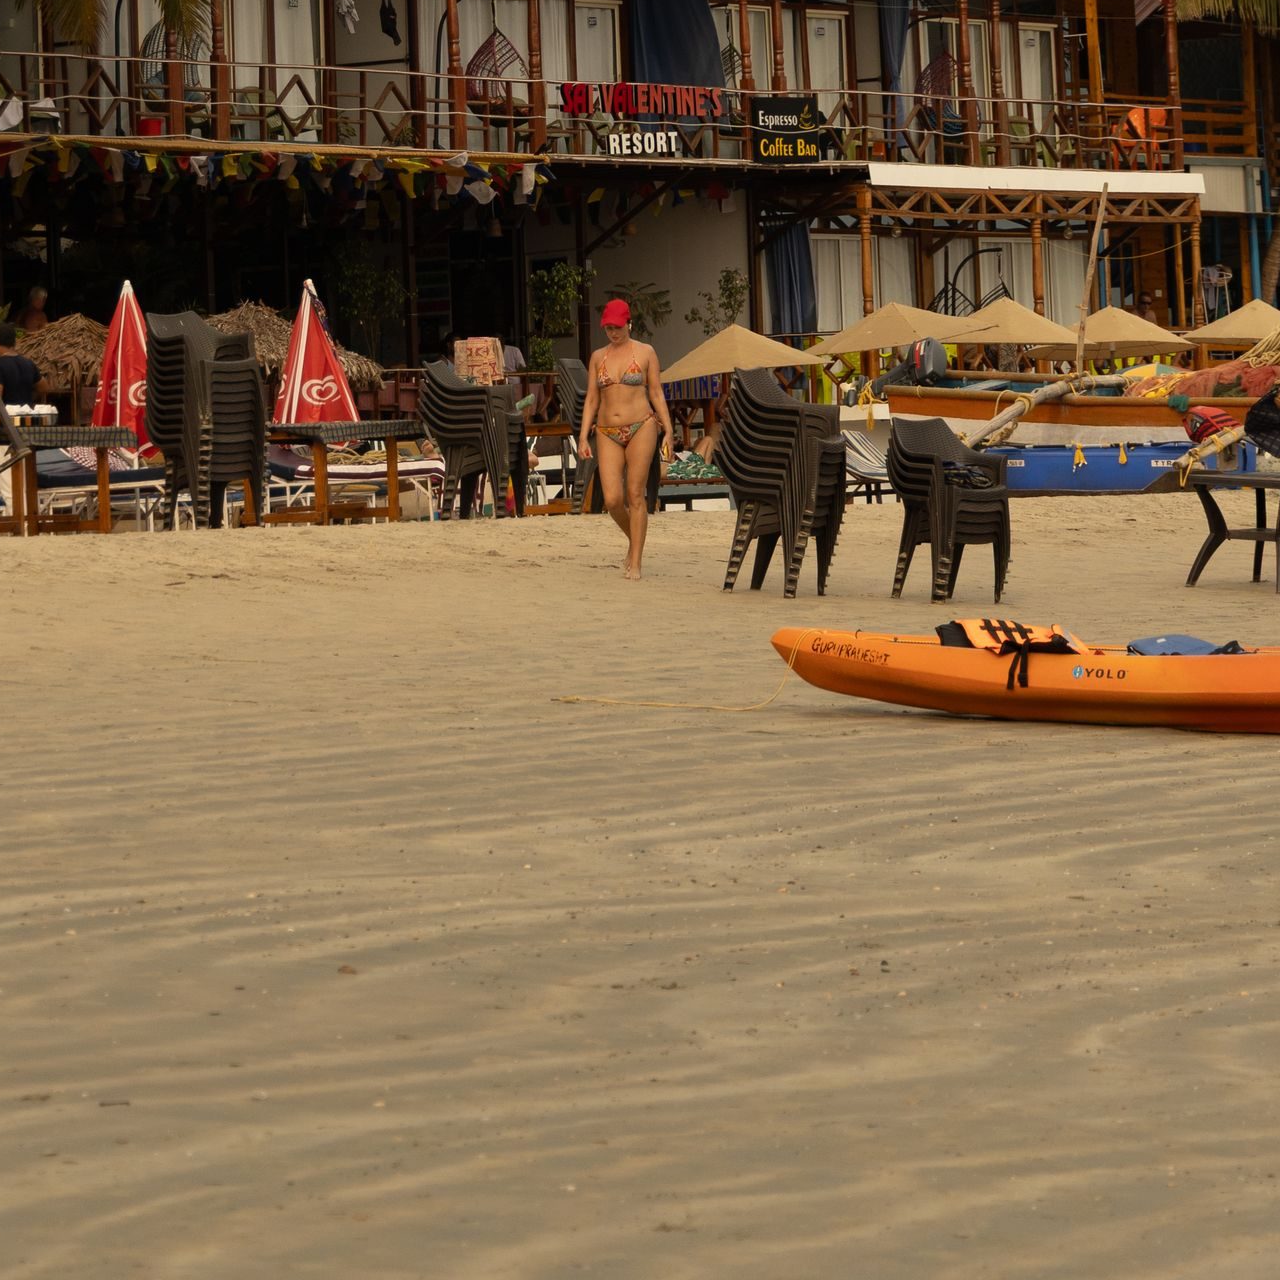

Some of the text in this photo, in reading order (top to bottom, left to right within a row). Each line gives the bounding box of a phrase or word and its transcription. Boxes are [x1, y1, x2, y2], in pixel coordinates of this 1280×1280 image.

[559, 82, 724, 118] SAI VALENTINE'S
[607, 131, 678, 155] RESORT
[1085, 667, 1127, 680] YOLO
